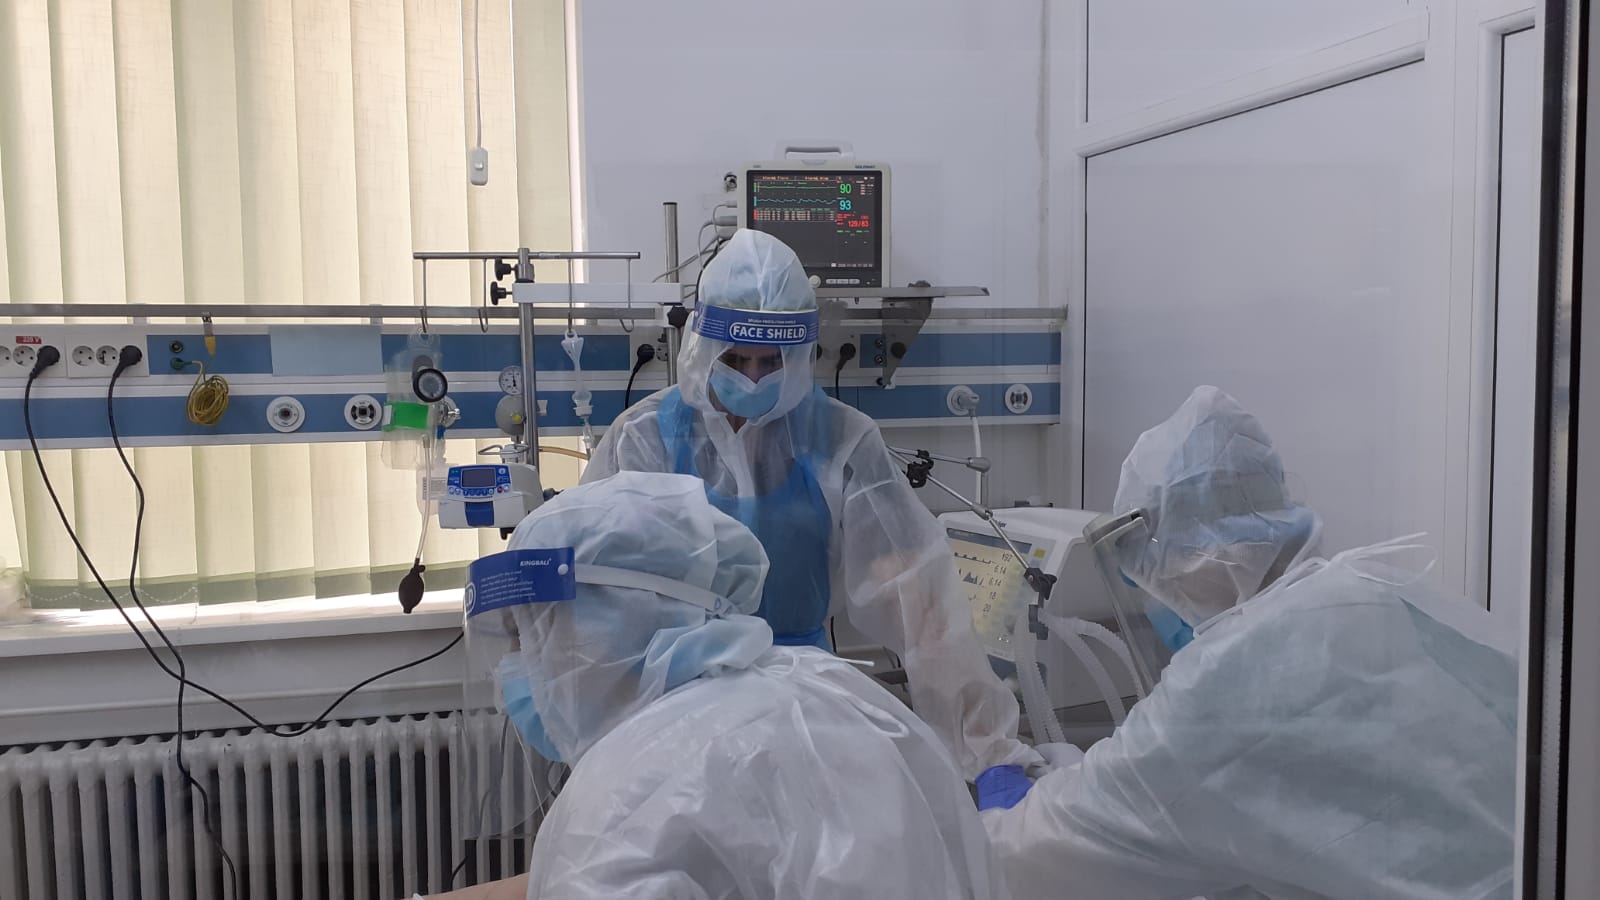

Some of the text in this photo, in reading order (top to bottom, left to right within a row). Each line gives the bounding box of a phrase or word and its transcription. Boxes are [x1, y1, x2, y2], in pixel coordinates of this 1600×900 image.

[840, 183, 851, 194] 90
[840, 200, 851, 210] 93
[733, 325, 764, 338] FACE
[766, 327, 805, 339] SHIELD
